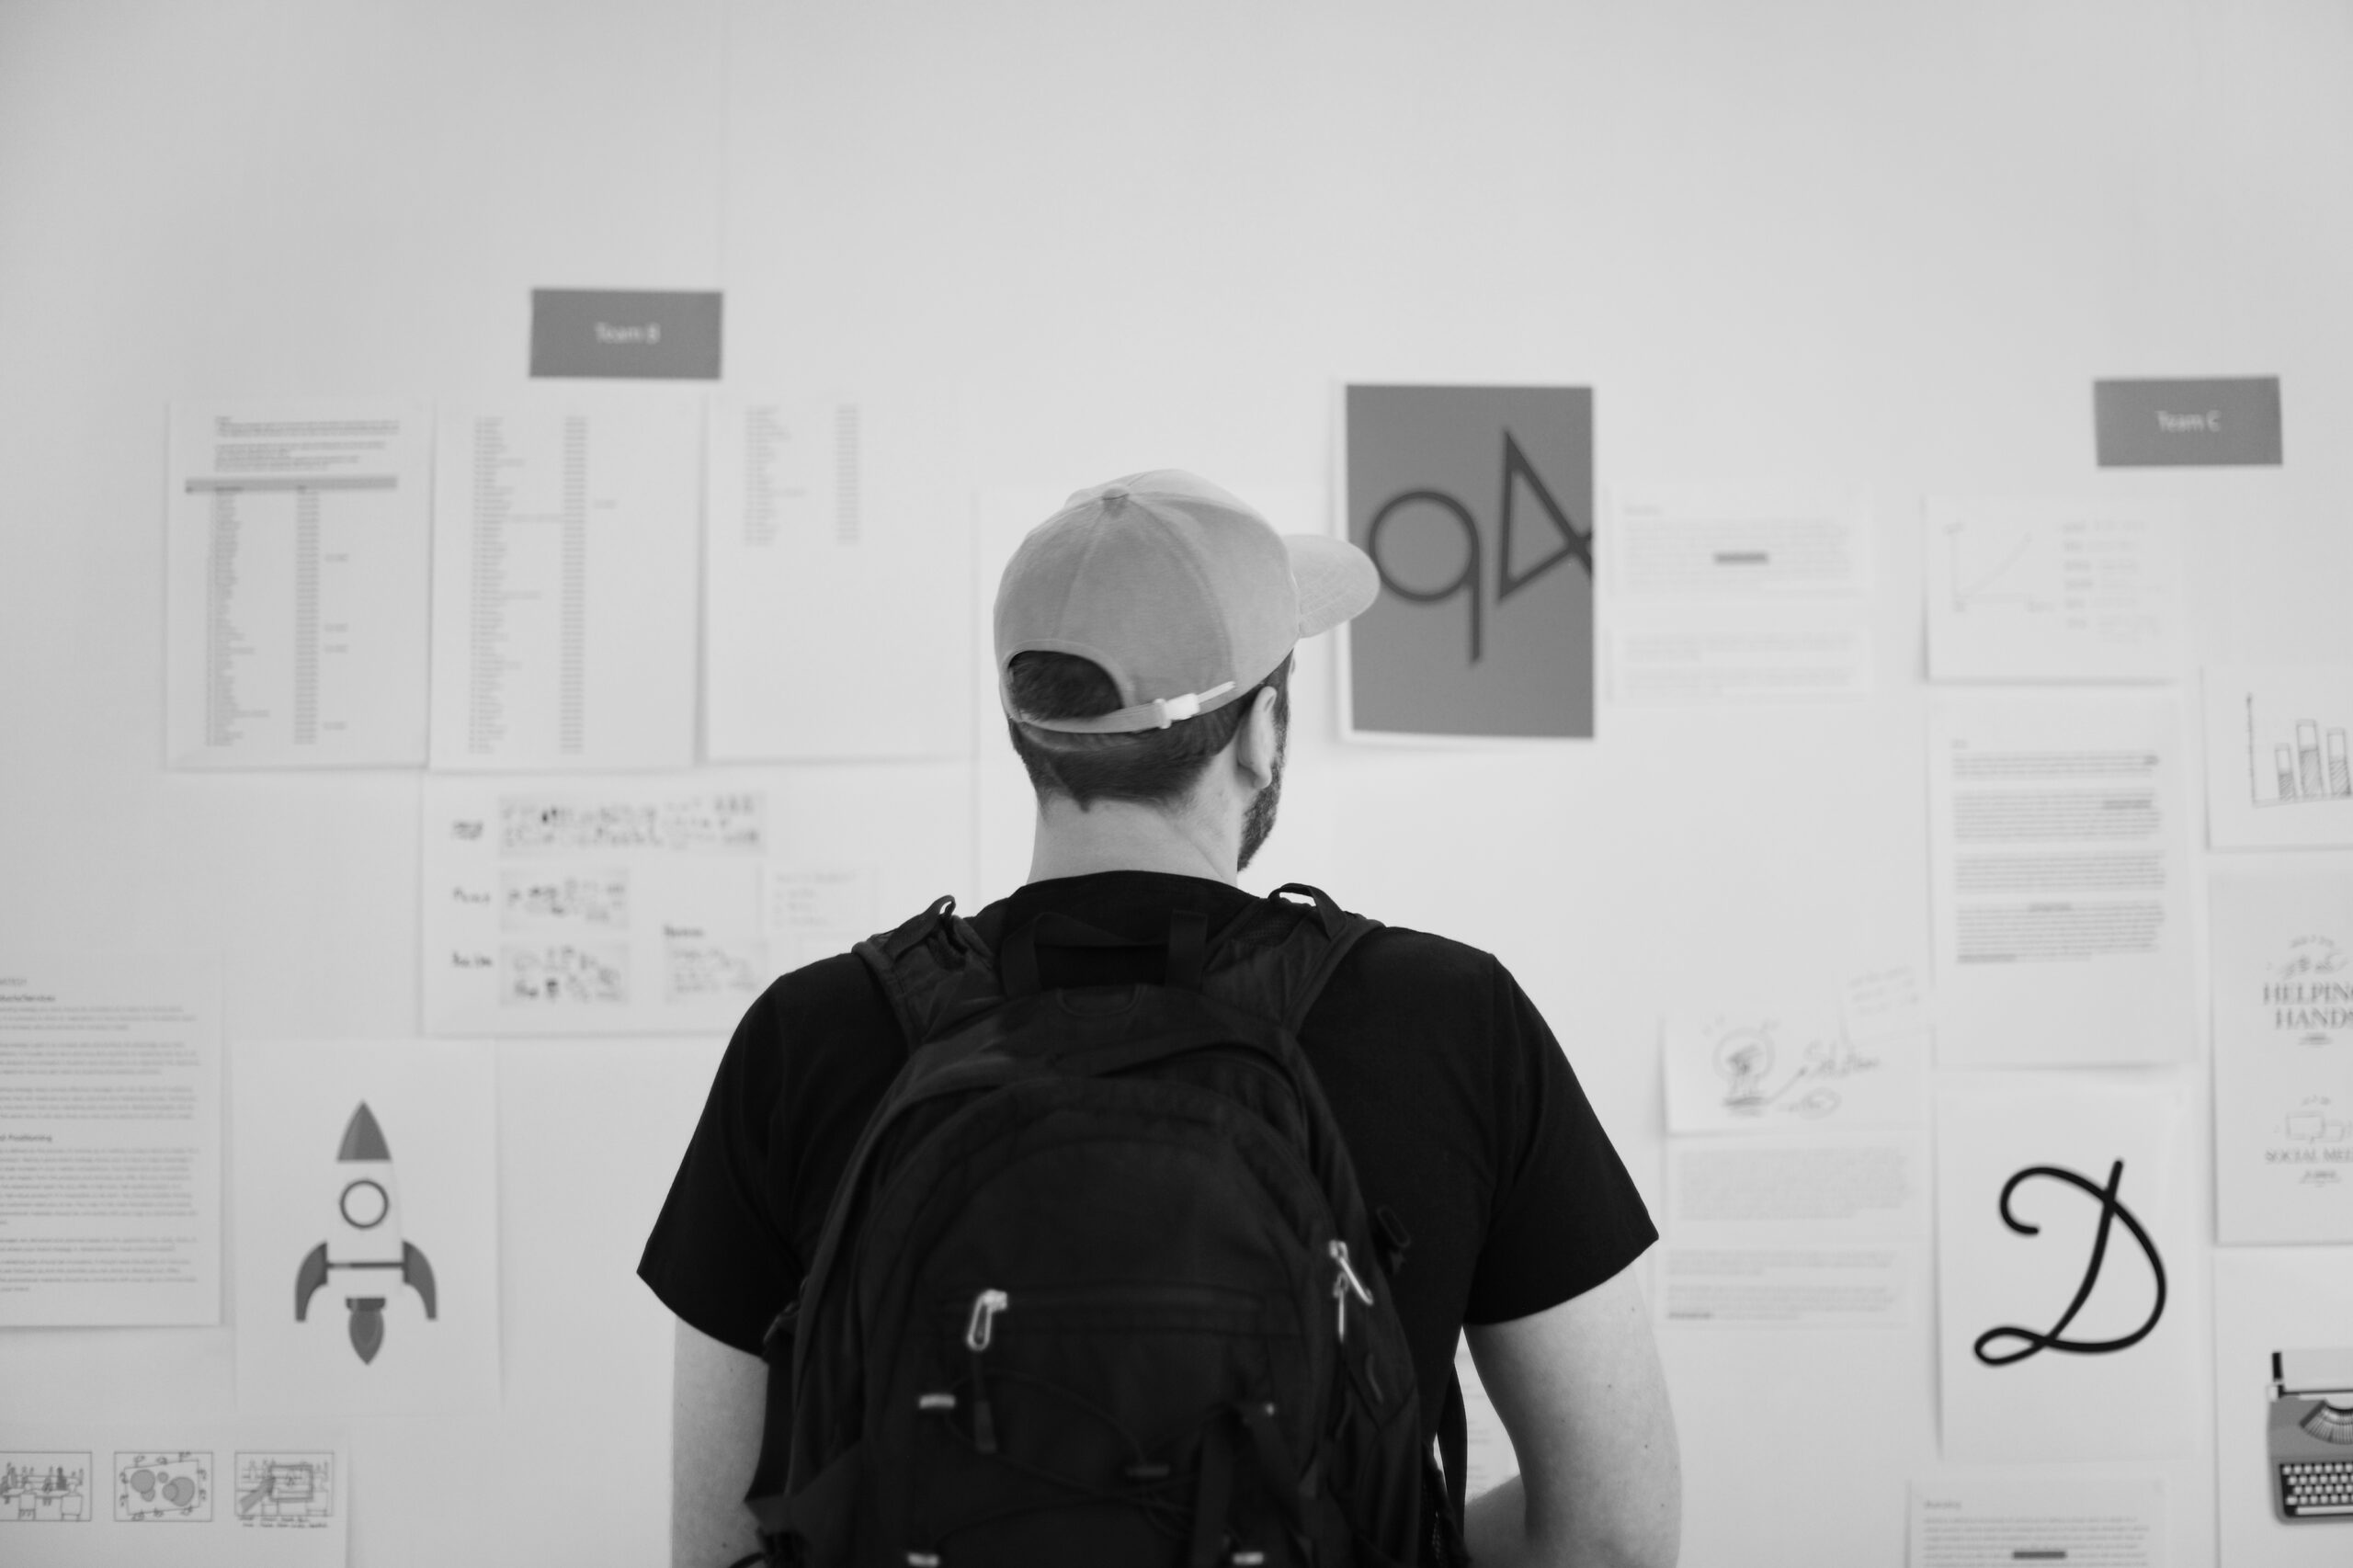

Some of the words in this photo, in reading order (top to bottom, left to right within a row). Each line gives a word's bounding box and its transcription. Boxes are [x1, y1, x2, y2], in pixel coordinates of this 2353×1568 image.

[2156, 410, 2205, 432] Team
[2207, 410, 2221, 432] C
[2263, 982, 2353, 1005] HELPIN
